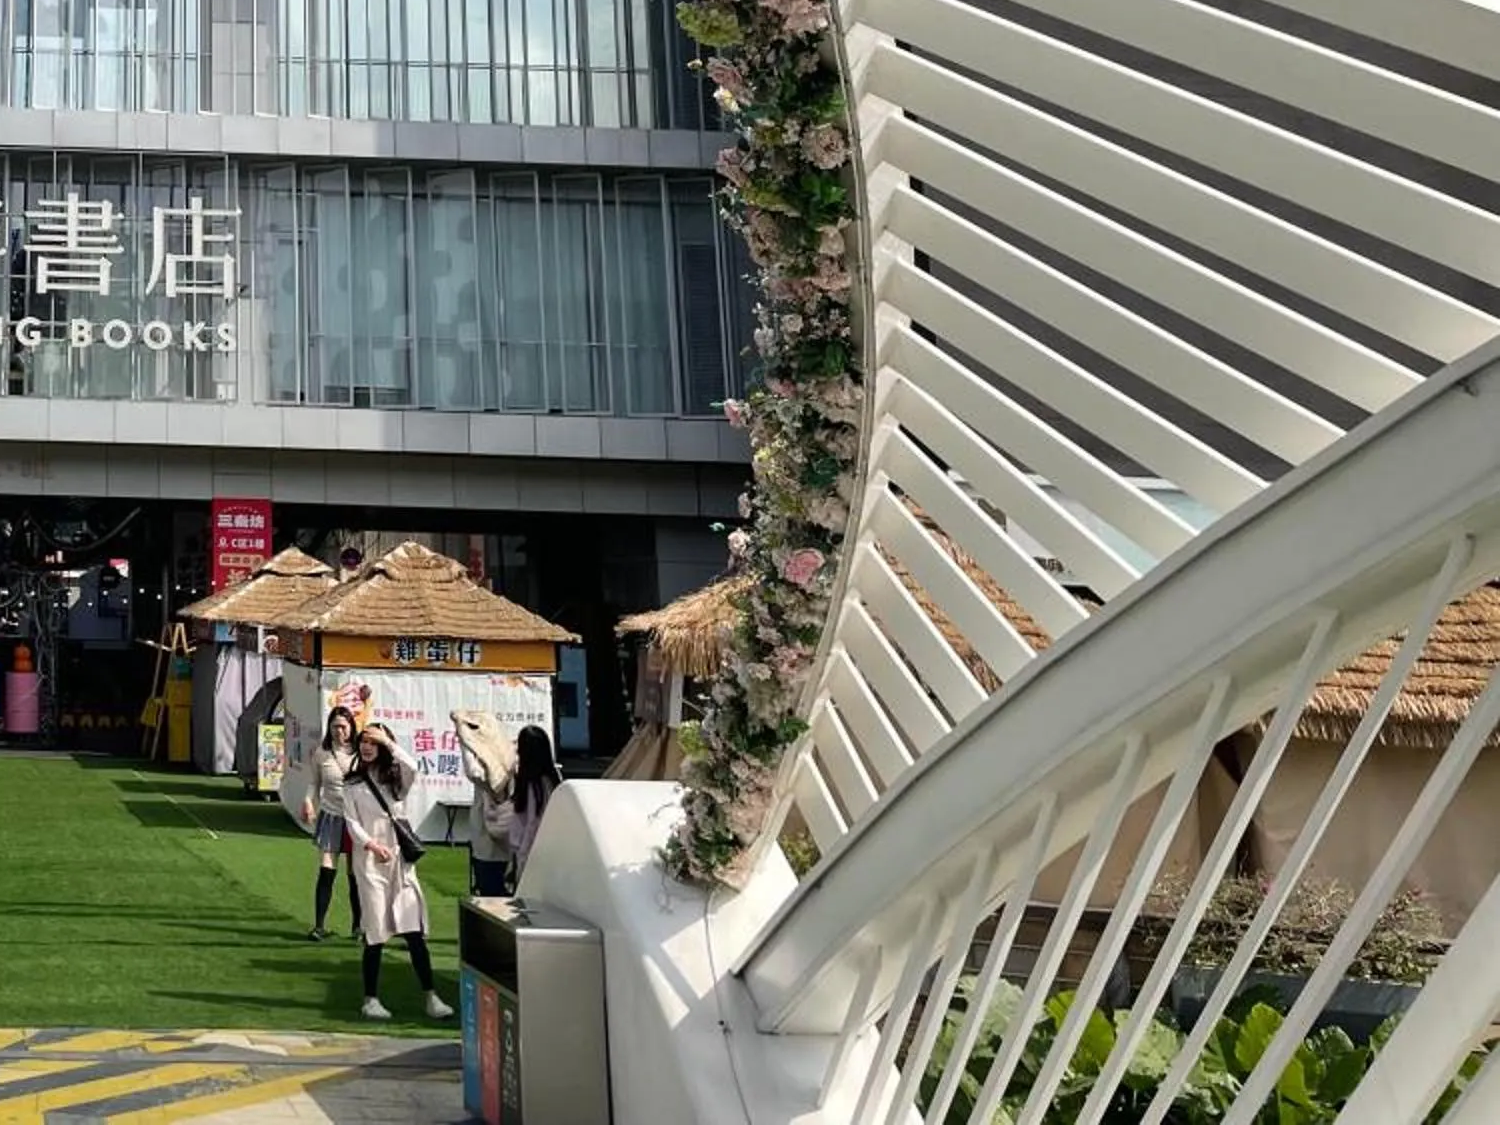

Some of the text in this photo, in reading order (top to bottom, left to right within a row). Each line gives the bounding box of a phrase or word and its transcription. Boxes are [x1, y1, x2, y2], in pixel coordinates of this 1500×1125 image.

[71, 317, 237, 352] BOOKS
[395, 638, 480, 665] 雞蛋仔
